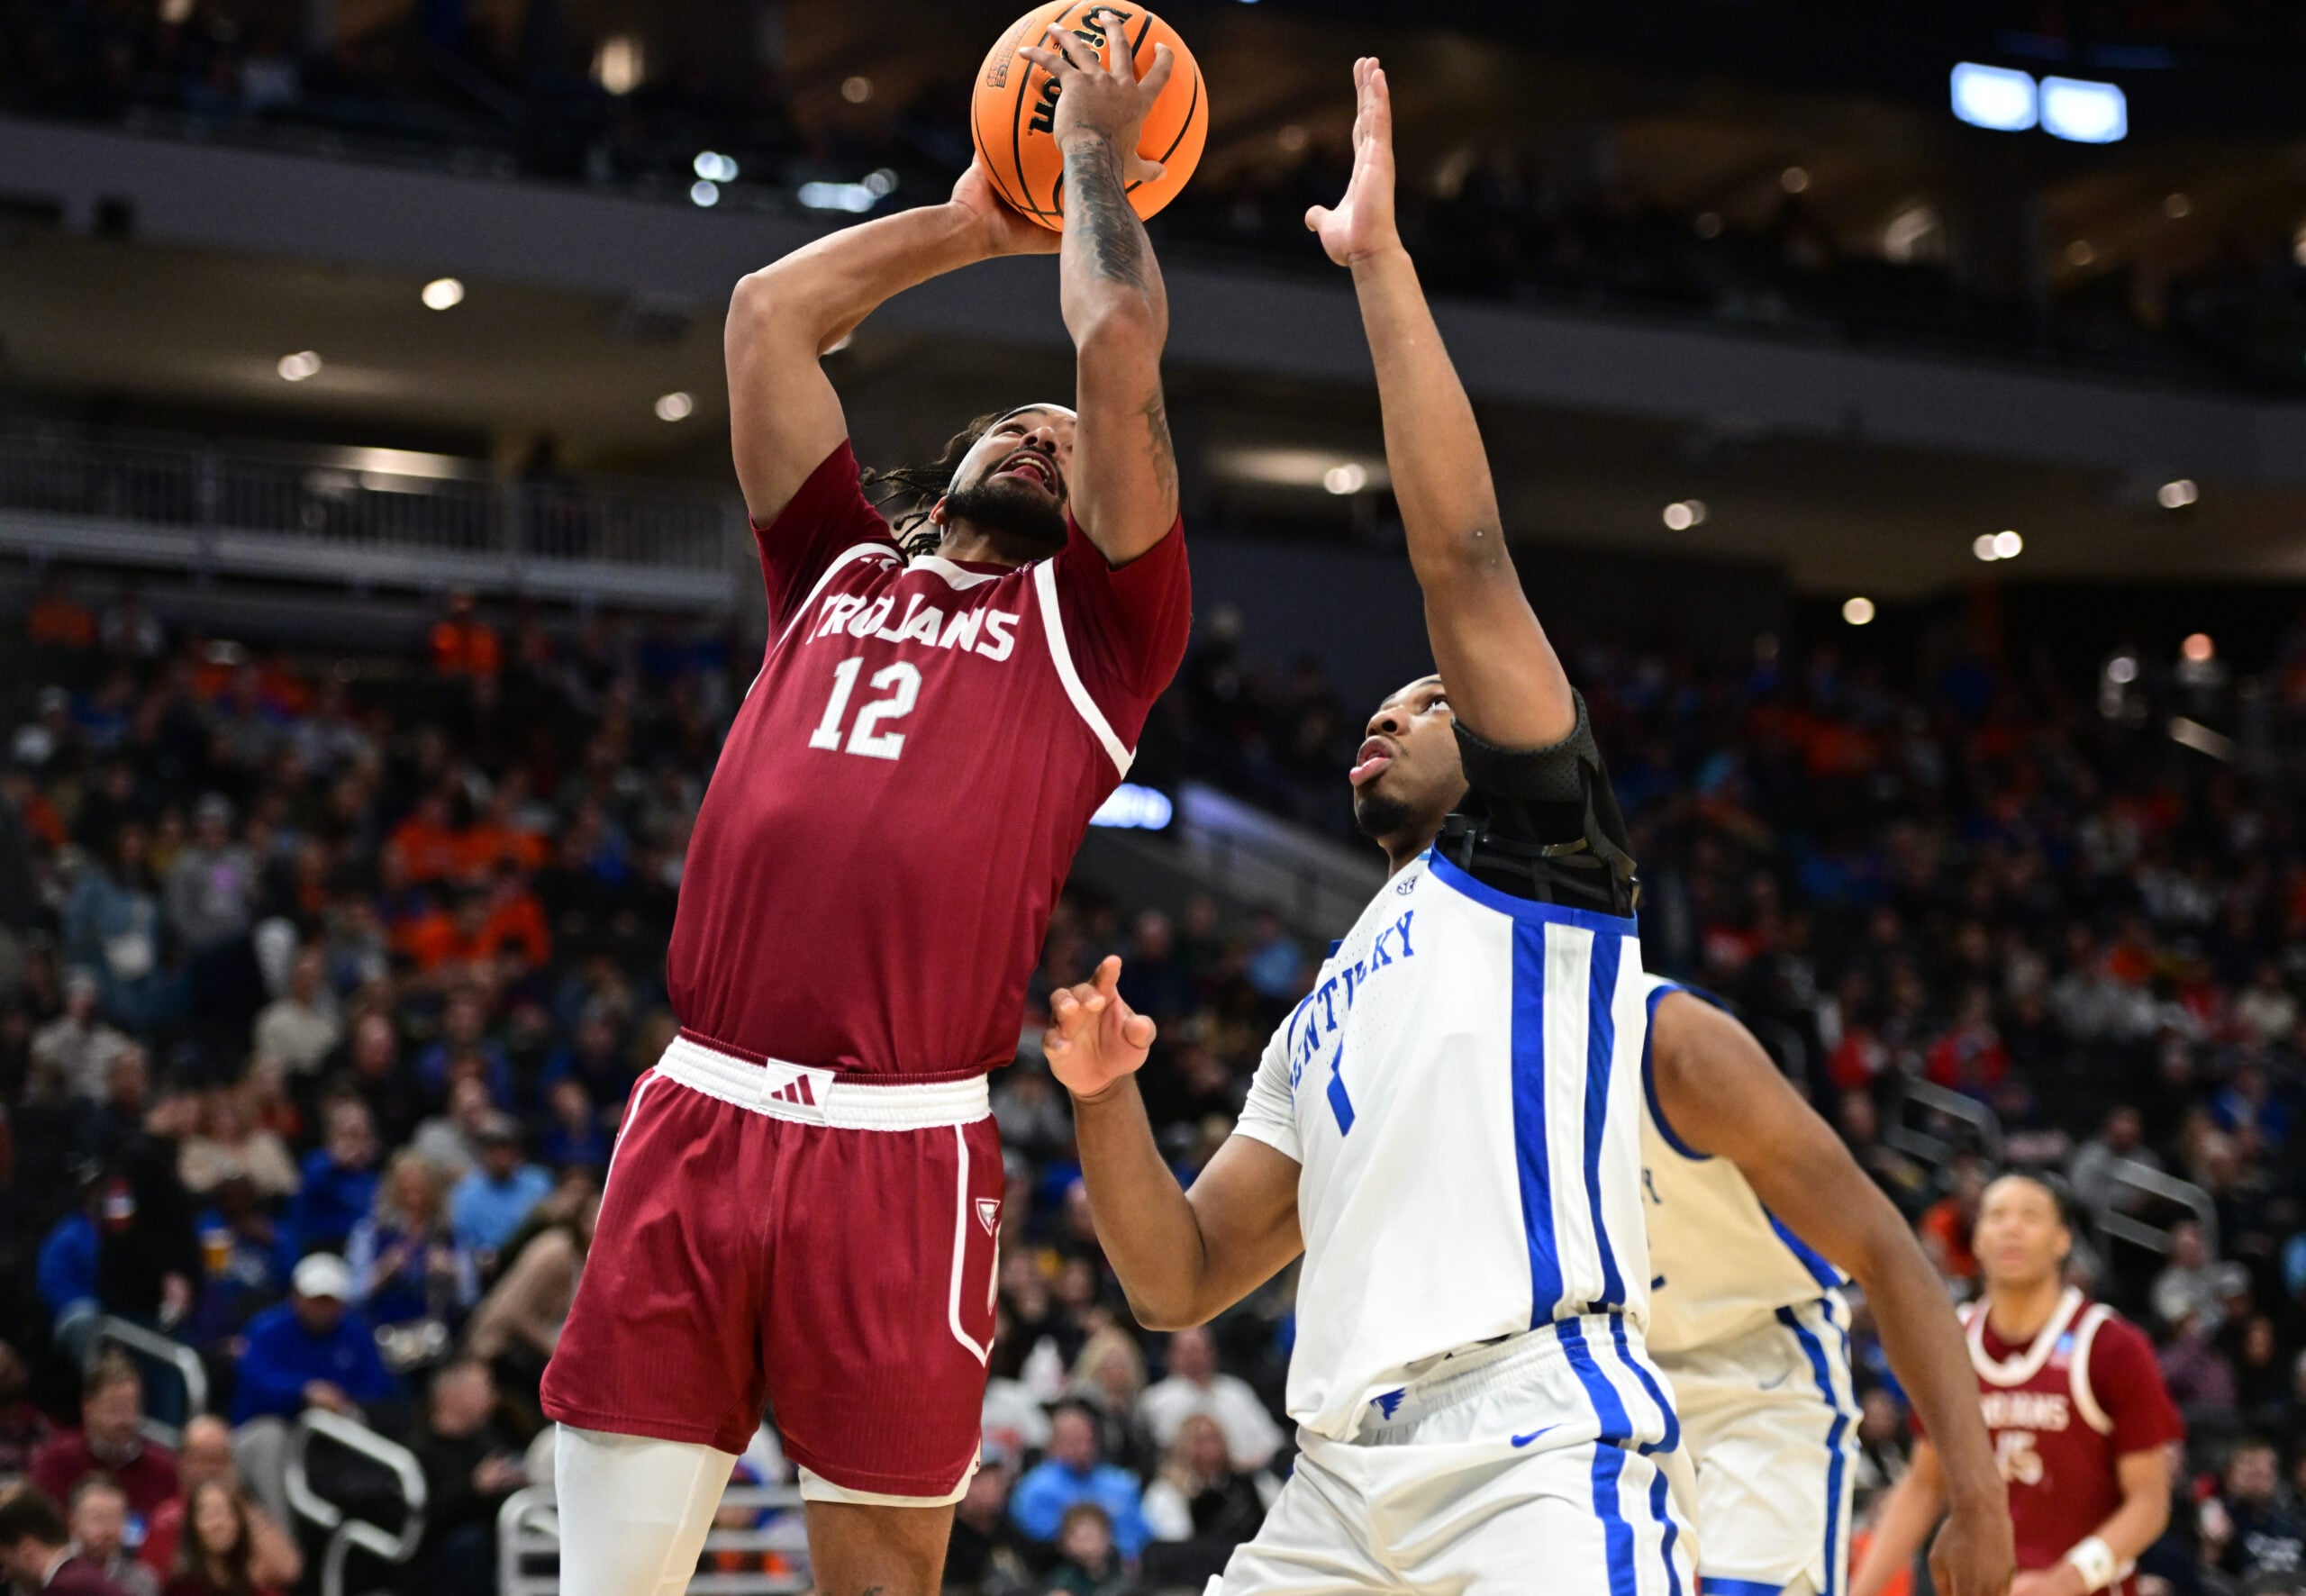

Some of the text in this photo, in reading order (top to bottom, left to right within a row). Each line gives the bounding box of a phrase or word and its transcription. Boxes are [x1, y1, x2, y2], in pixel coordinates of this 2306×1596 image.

[805, 593, 1020, 662] TROJANS
[808, 656, 922, 761] 12
[1327, 1031, 1356, 1138] 1
